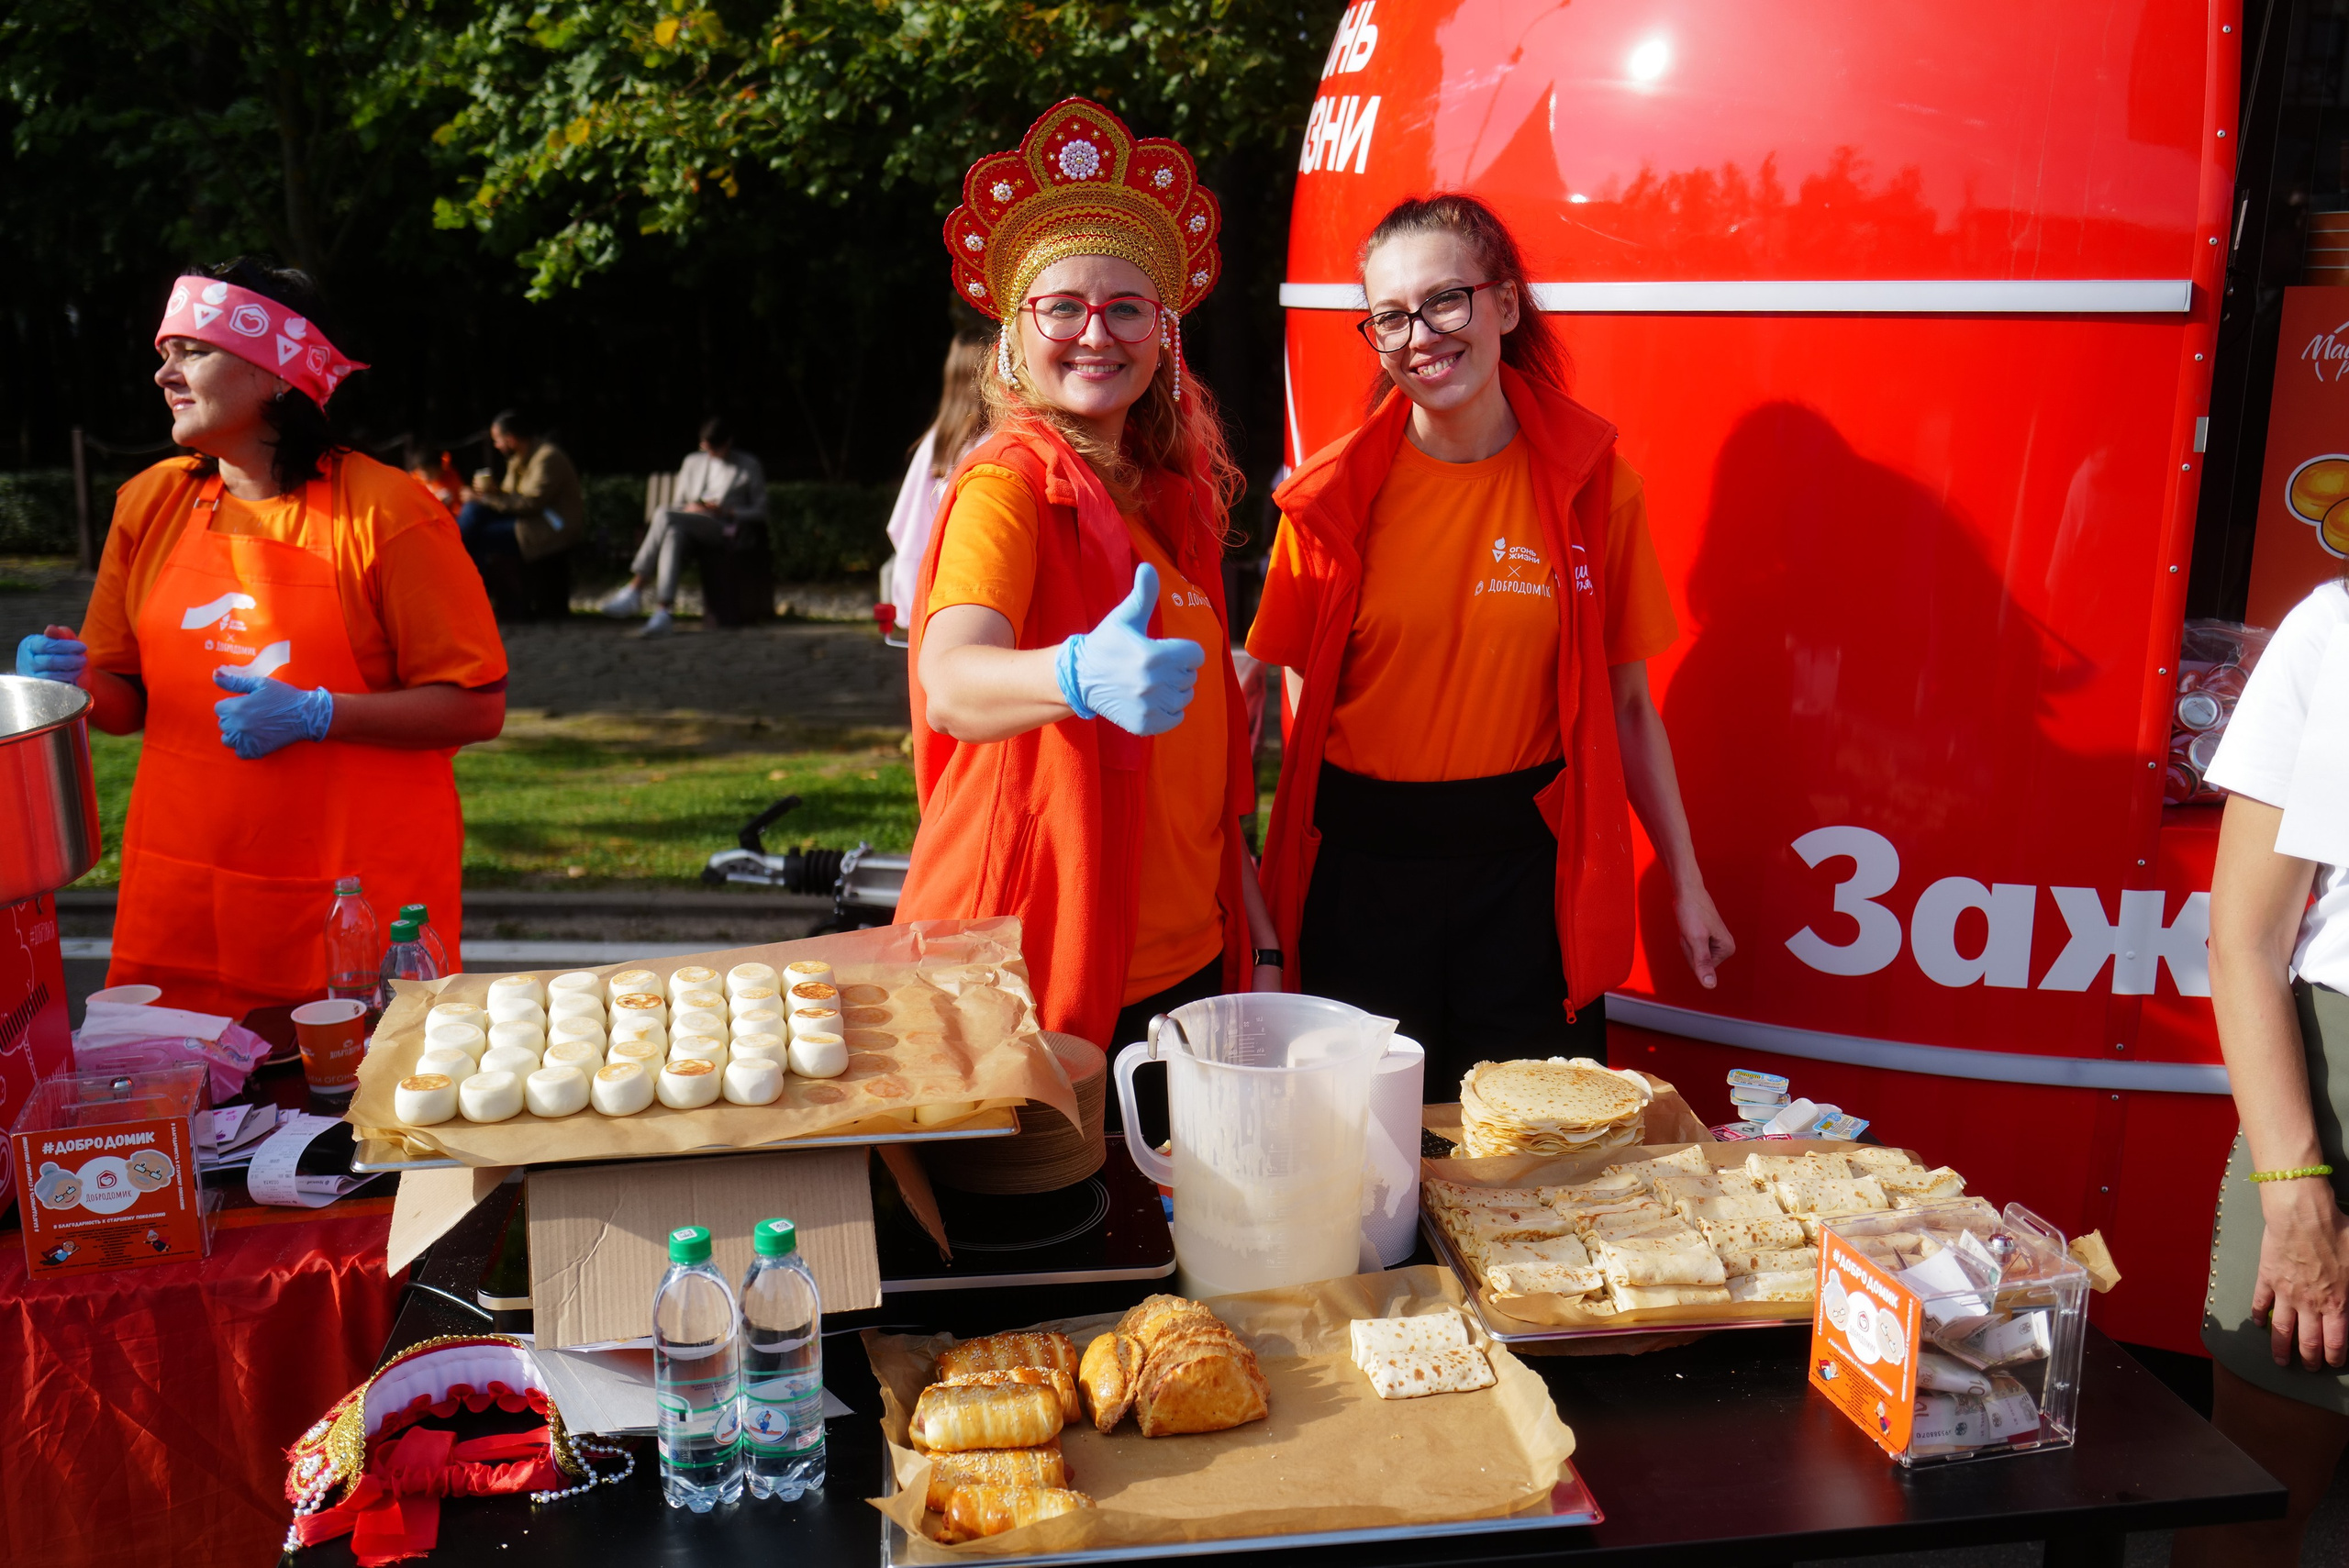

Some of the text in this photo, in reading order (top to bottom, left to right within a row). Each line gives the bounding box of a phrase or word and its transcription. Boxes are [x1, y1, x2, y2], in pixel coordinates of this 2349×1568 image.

[1508, 546, 1537, 557] ОГОНЬ
[1508, 553, 1541, 564] ЖИЗНИ
[42, 1131, 156, 1155] #ДОБРОДОМИК
[85, 1190, 133, 1203] ДОБРОДОМИК
[58, 1218, 102, 1229] БЛАГОДАРНОСТЬ
[106, 1215, 136, 1224] СТАРШЕМУ
[1831, 1248, 1900, 1310] #ДОБРОДОМИК
